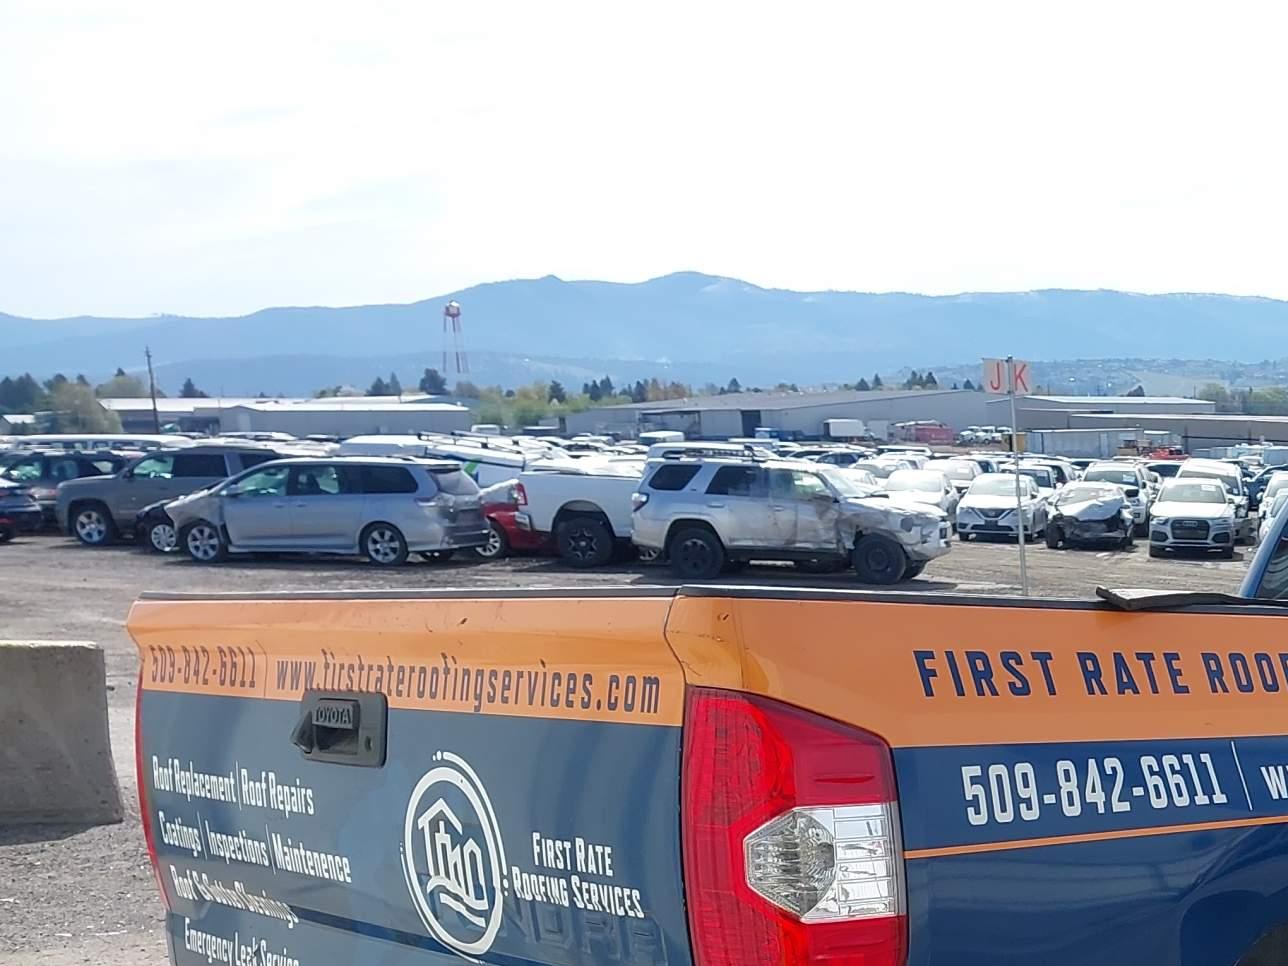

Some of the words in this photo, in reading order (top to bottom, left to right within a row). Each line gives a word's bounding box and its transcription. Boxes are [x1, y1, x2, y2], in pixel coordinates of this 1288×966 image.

[990, 362, 1001, 391] J
[1013, 363, 1029, 393] K
[149, 645, 256, 689] 509-842-6611
[277, 649, 660, 713] www.firstrateroofingservices.com
[913, 650, 1057, 697] FIRST
[1076, 651, 1191, 696] RATE
[315, 707, 353, 725] TOYOTA
[152, 756, 173, 792] Roof
[173, 758, 236, 802] Replacement
[240, 769, 268, 808] Roof
[268, 771, 315, 819] Repairs
[961, 752, 1228, 827] 509-842-6611
[158, 811, 201, 857] Coatings
[205, 820, 270, 866] Inspections
[272, 833, 353, 883] Maintenence
[532, 832, 571, 870] FIRST
[575, 837, 614, 877] RATE
[170, 865, 198, 900] Roof
[511, 866, 569, 907] ROOFING
[571, 876, 645, 918] SERVICES
[235, 932, 259, 966] Leak
